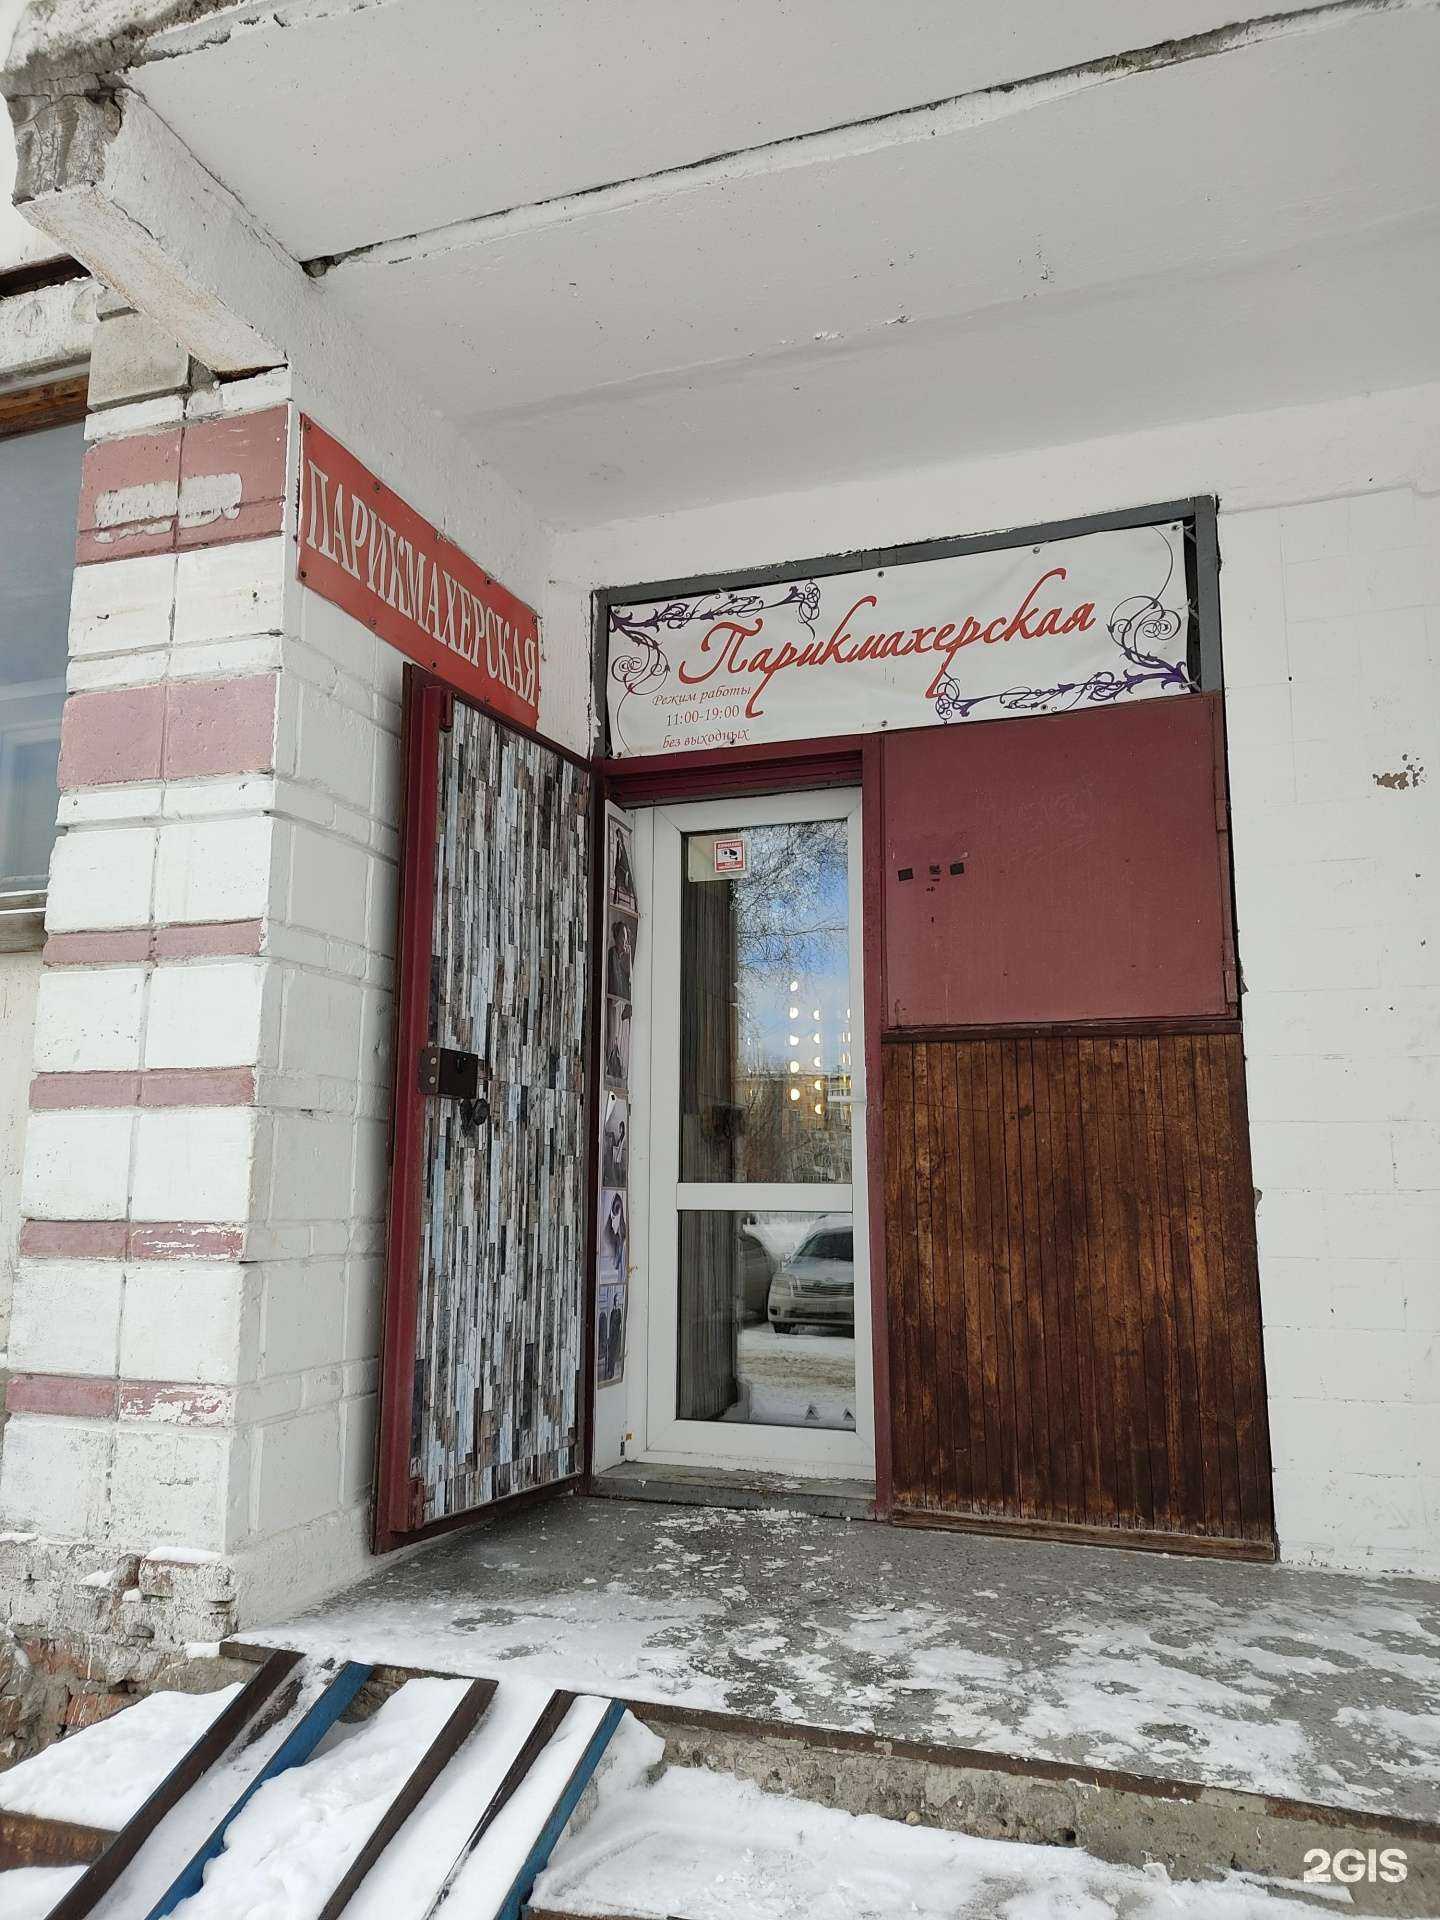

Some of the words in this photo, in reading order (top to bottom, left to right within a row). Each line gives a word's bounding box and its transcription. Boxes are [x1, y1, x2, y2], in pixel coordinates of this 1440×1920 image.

[306, 459, 536, 707] ПАРИКМАХЕРСКАЯ
[678, 567, 1098, 719] Парикмахерская
[652, 692, 696, 706] Режим
[699, 684, 752, 704] работы
[666, 704, 740, 727] 11:00-19:00
[662, 734, 681, 749] без
[684, 728, 751, 746] выходных
